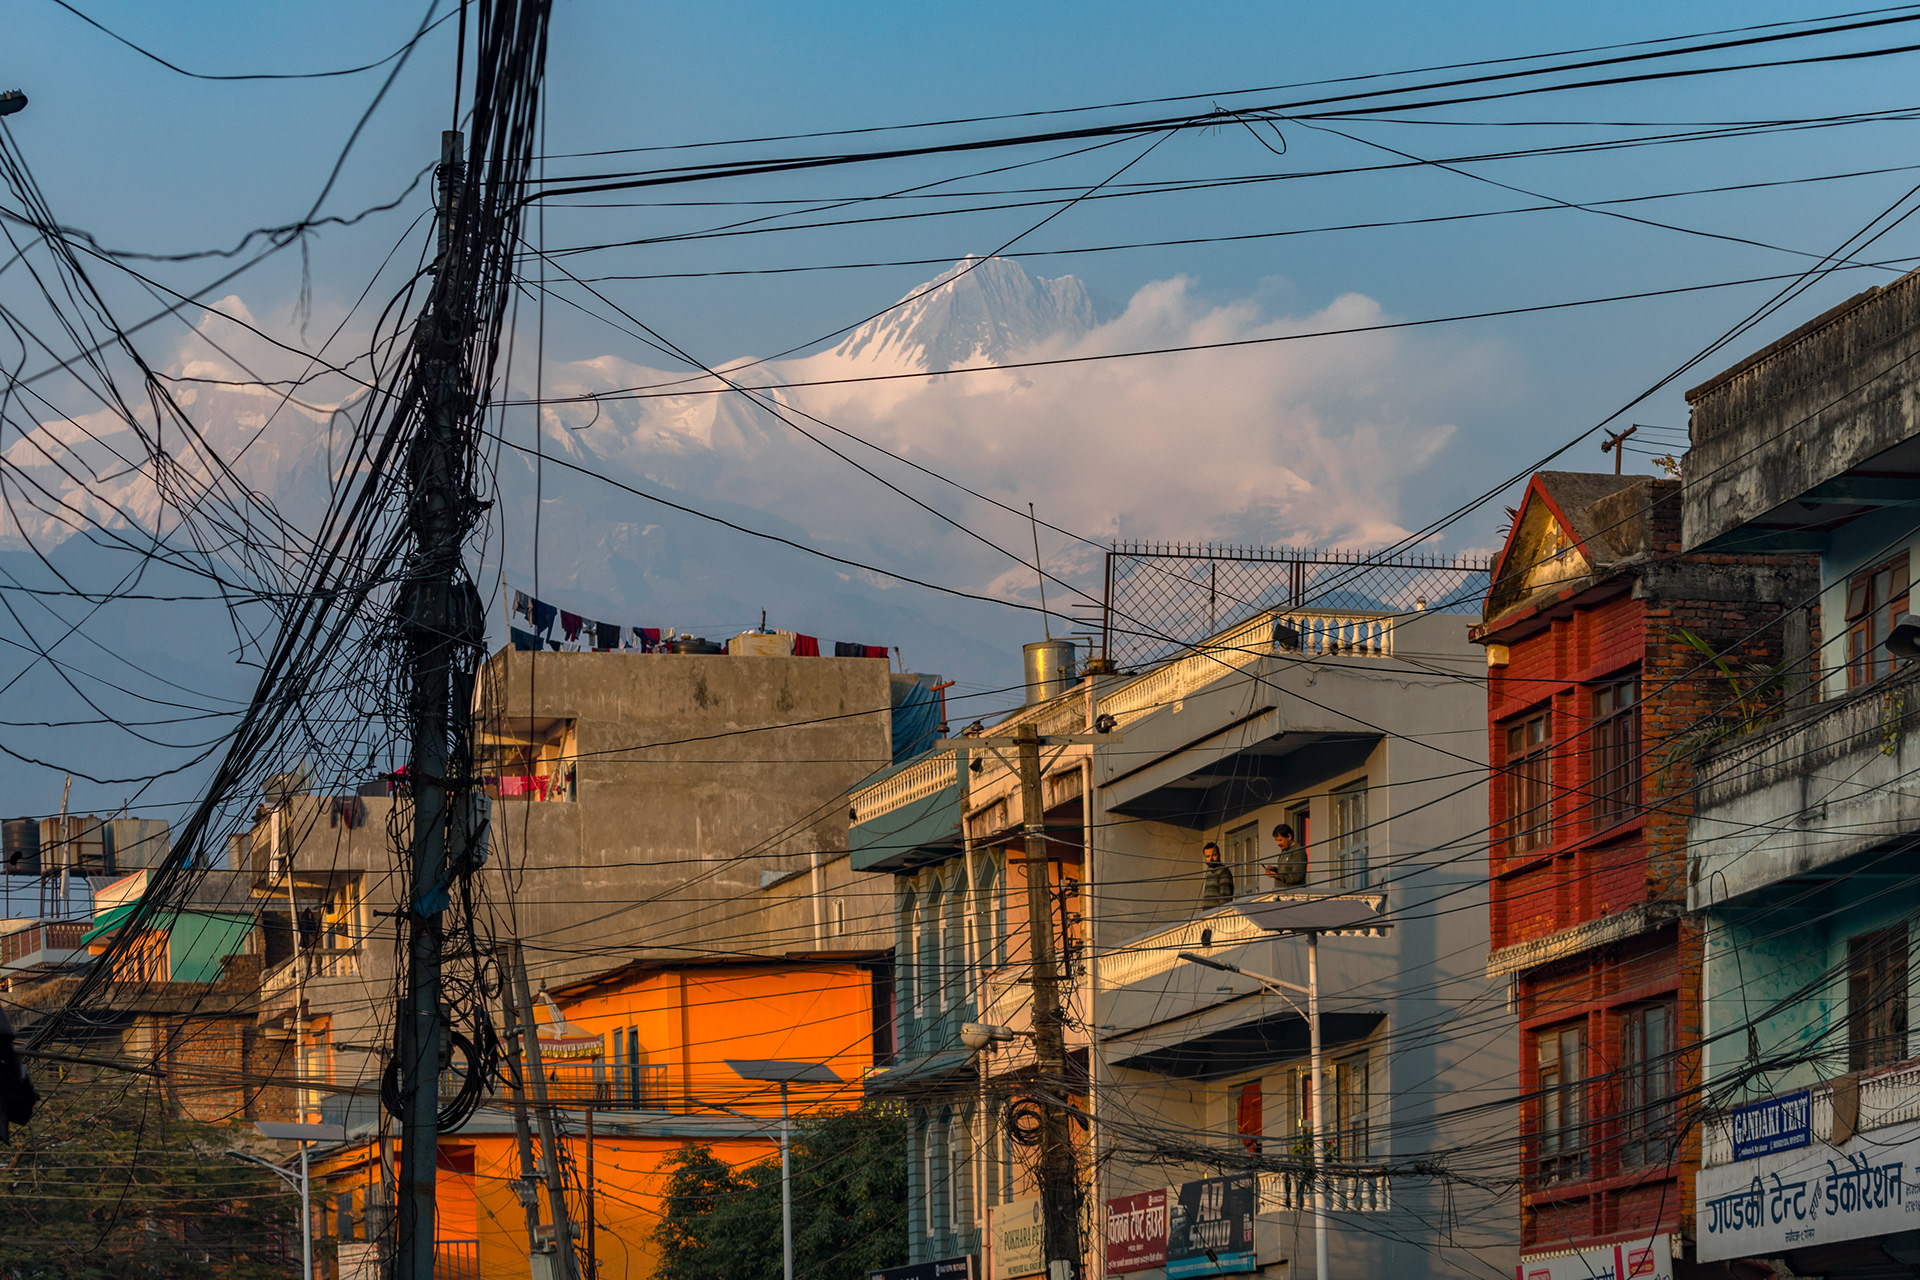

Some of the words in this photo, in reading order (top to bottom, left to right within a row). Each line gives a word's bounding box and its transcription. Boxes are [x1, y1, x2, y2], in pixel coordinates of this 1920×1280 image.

[1735, 1105, 1780, 1144] GANDAKI
[1781, 1096, 1808, 1132] TENT
[1197, 1182, 1224, 1222] AR
[1706, 1176, 1765, 1234] गण्डकी
[1769, 1172, 1807, 1224] टेन्ट
[1825, 1151, 1903, 1216] डेकोरेशन
[1004, 1227, 1032, 1251] POKHARA
[1189, 1220, 1231, 1250] SOUND
